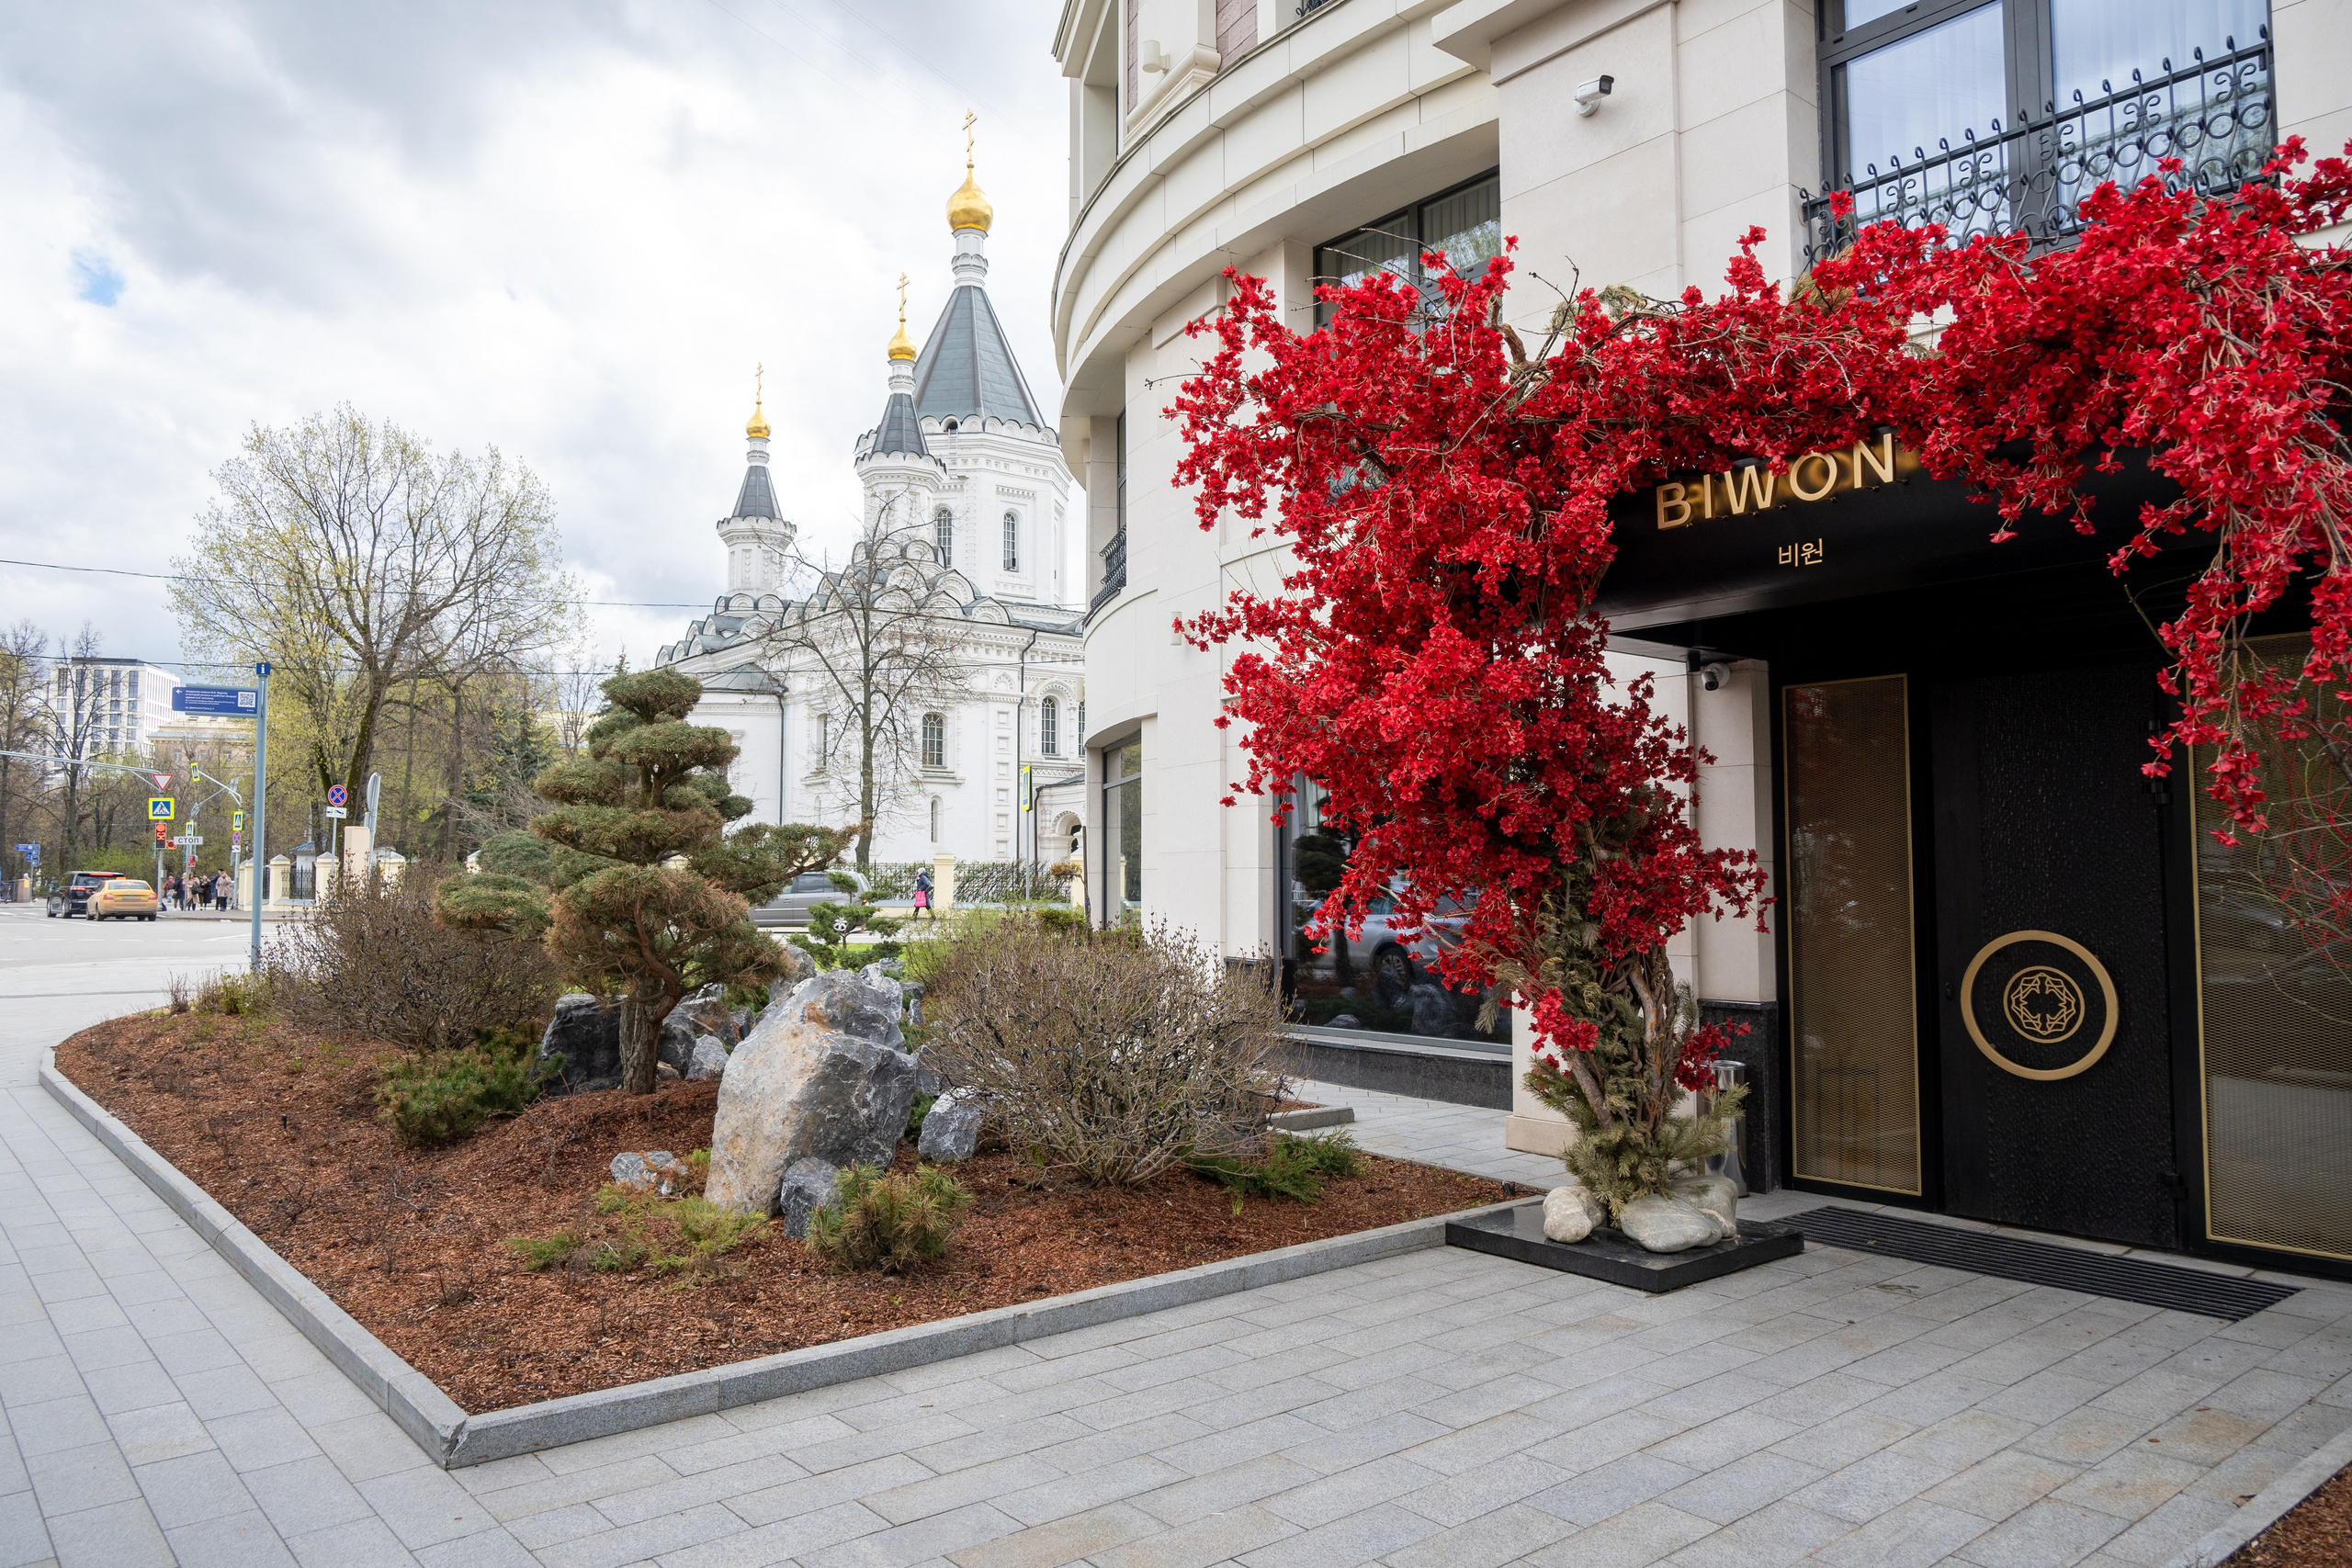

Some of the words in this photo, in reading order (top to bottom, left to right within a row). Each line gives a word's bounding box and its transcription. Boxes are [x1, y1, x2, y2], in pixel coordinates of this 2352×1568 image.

[1657, 433, 1896, 530] BIWON
[1779, 538, 1824, 567] 비원
[156, 831, 166, 840] 52
